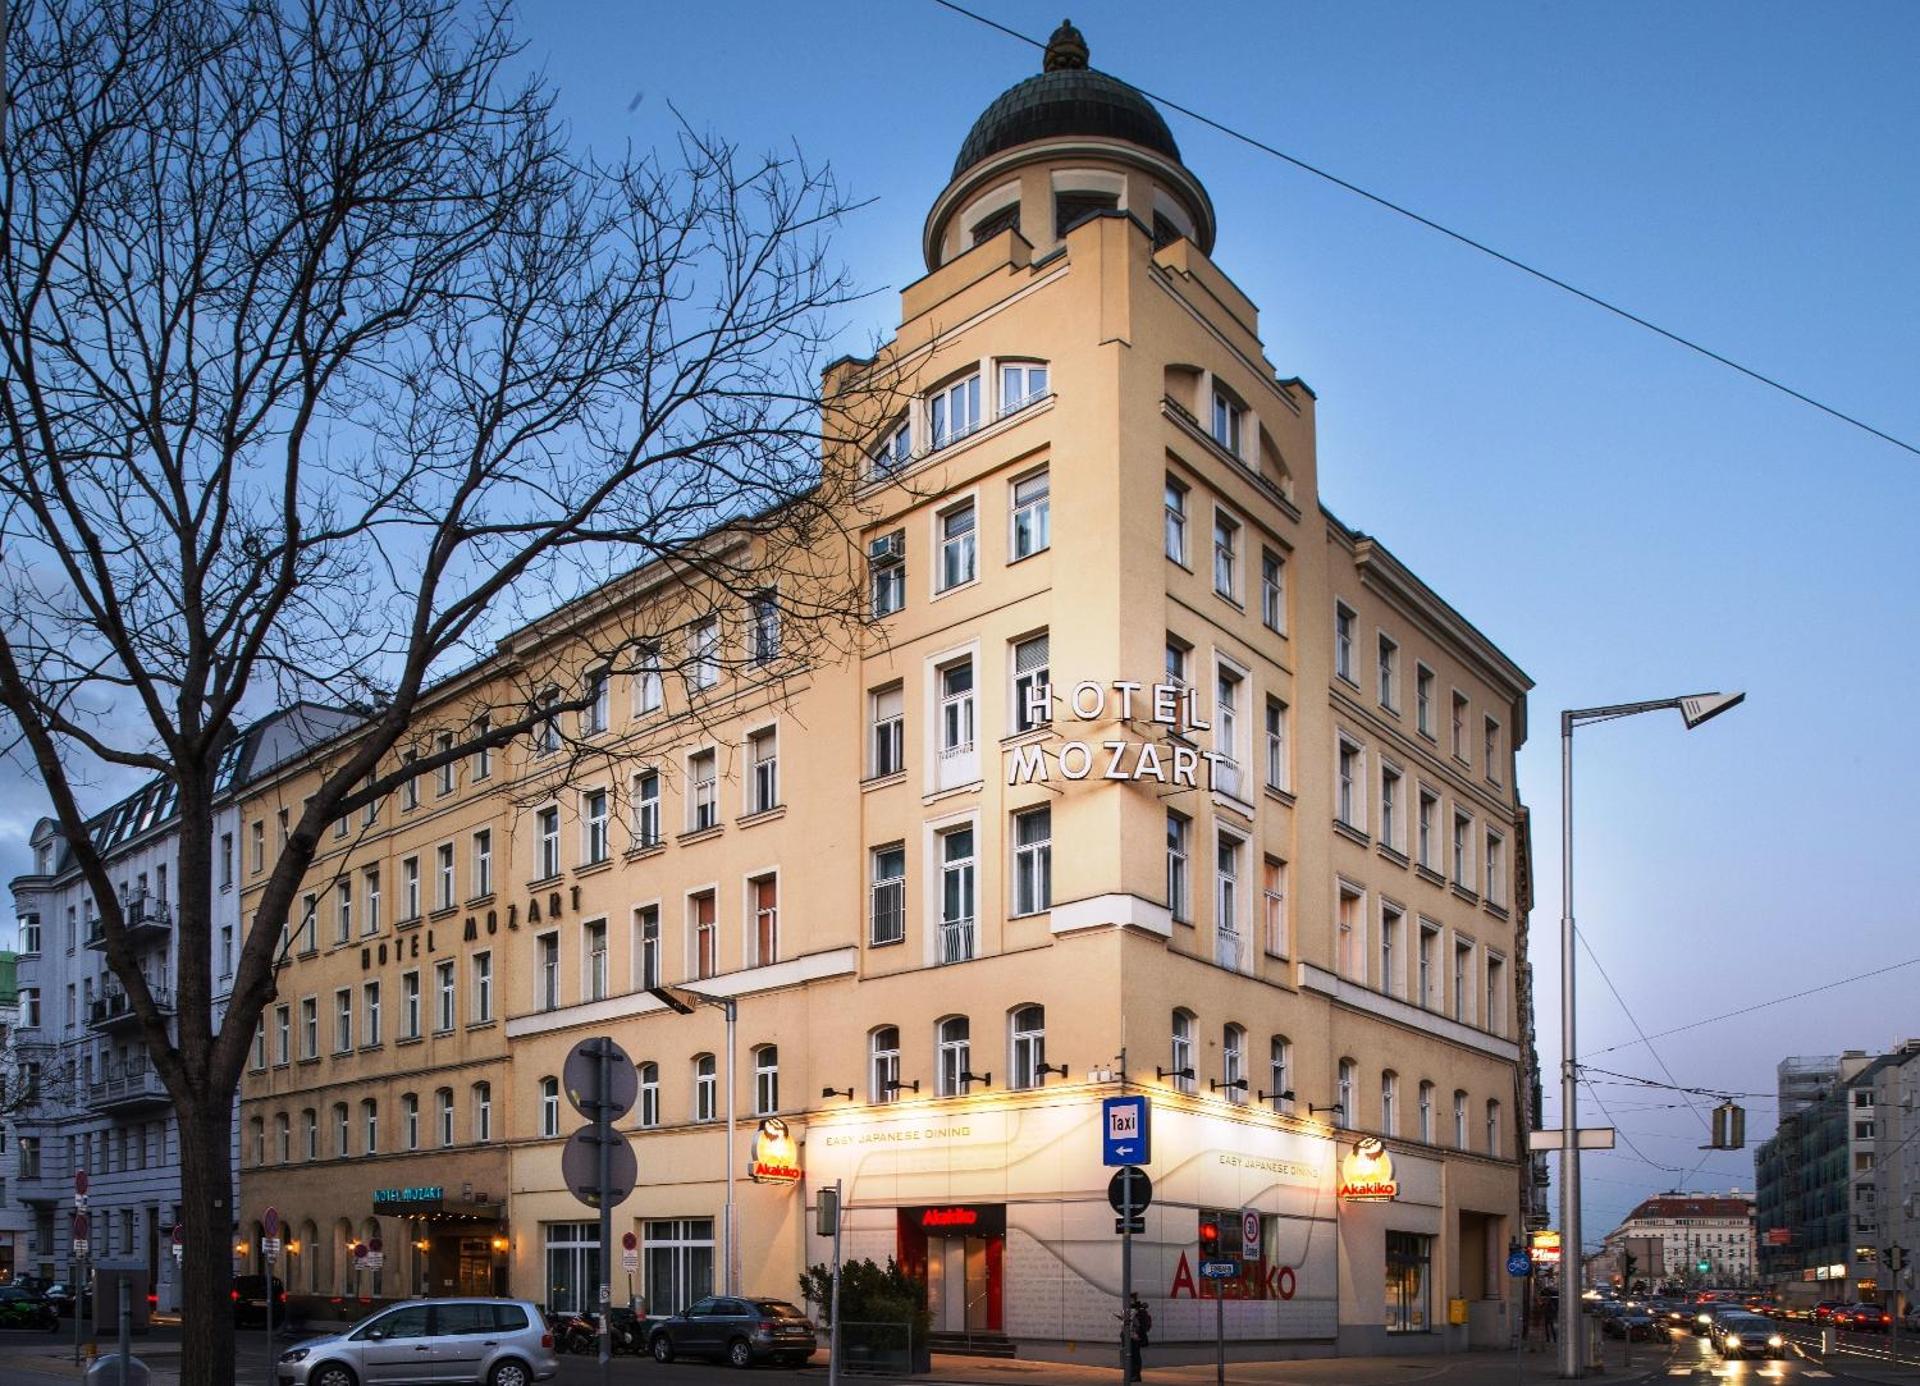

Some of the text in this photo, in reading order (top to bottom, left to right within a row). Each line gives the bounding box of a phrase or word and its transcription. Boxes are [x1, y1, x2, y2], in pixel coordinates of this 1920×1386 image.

[1025, 680, 1212, 731] HOTEL
[1008, 740, 1225, 792] MOZART
[361, 885, 581, 970] HOTEL MOZART
[1110, 1112, 1136, 1132] Taxi
[826, 1127, 971, 1146] EASY JAPANESE DINING
[755, 1163, 800, 1178] Akakiko
[1244, 1160, 1289, 1175] JAPANESE
[1341, 1182, 1395, 1195] Akakiko
